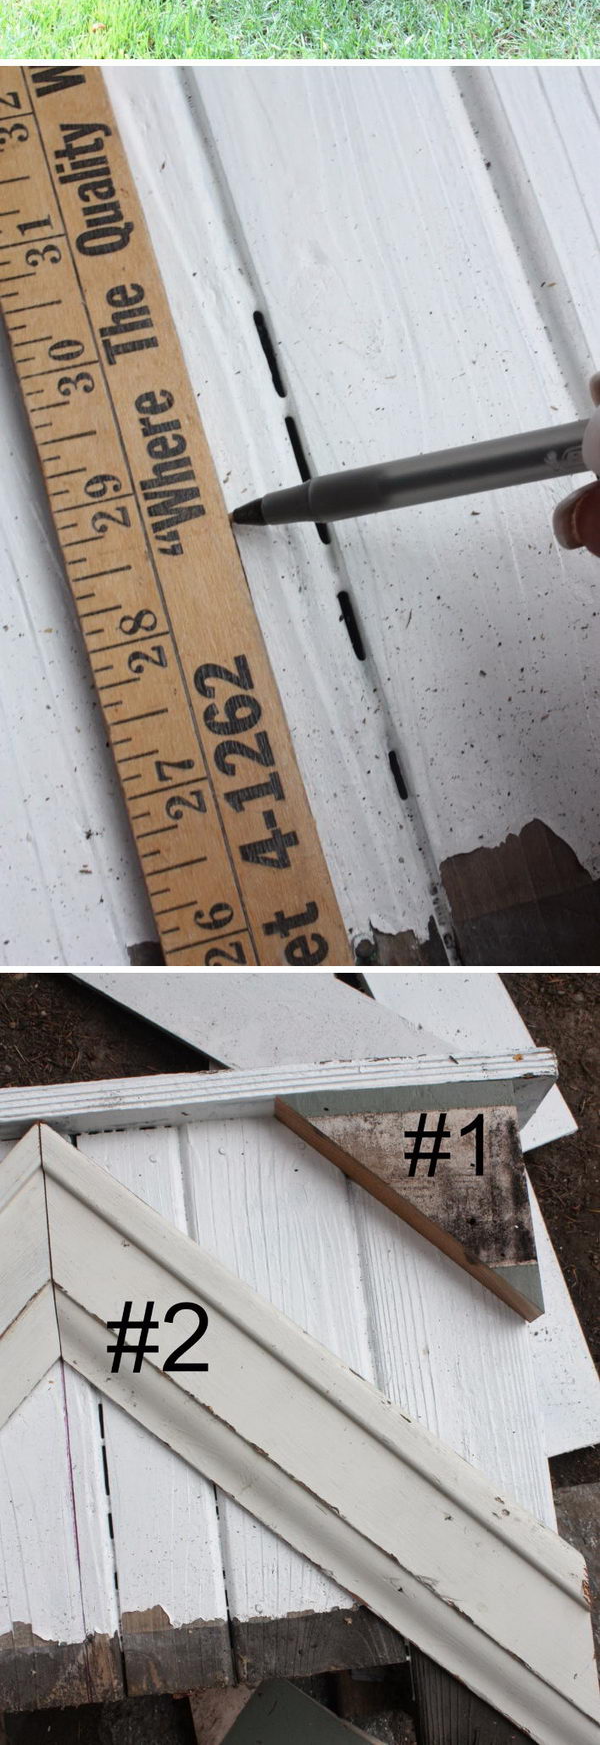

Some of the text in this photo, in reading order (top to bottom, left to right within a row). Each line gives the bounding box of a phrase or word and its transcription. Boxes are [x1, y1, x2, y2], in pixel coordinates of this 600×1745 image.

[54, 122, 135, 257] Quality
[16, 213, 62, 268] 31
[98, 282, 159, 366] The
[48, 339, 95, 396] 30
[84, 473, 132, 534] 29
[119, 608, 168, 674] 28
[155, 758, 207, 821] 27
[193, 654, 299, 870] 4-1262
